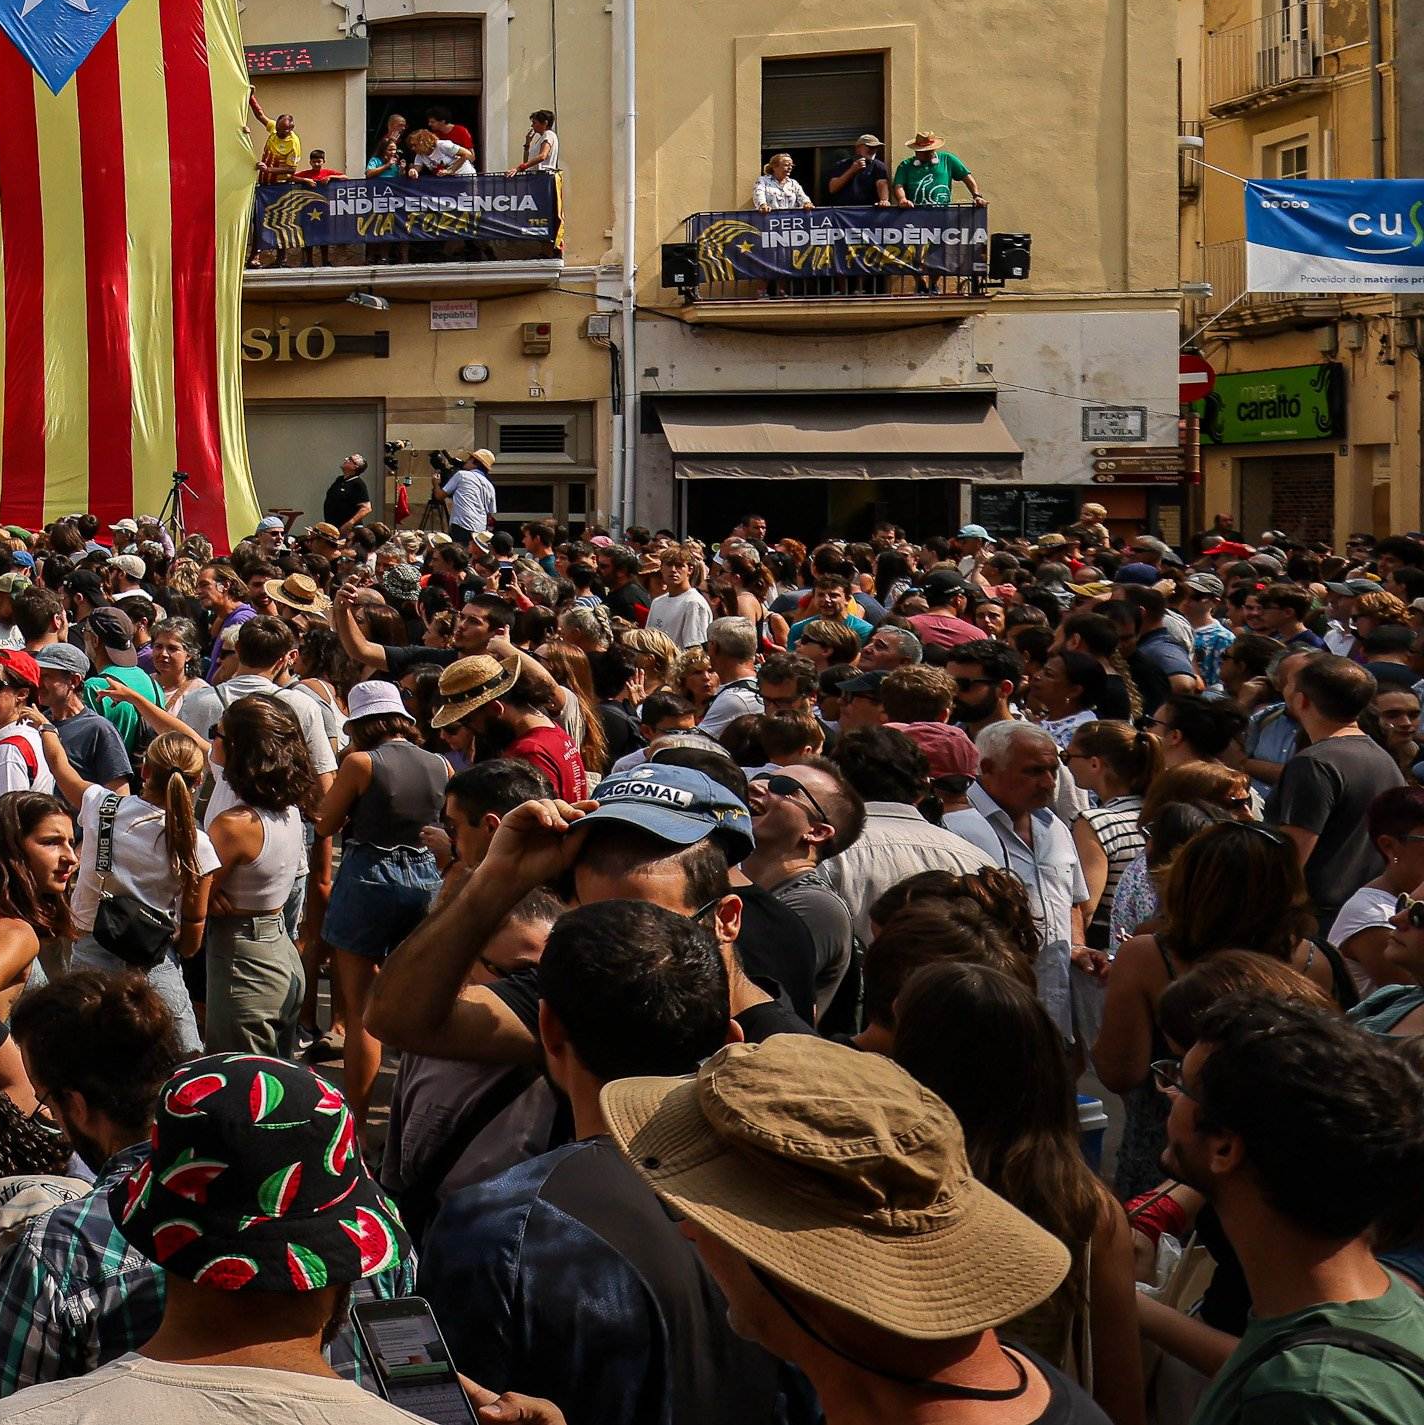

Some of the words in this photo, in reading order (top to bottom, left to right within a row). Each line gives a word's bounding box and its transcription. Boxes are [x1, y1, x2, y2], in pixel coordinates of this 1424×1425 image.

[329, 192, 538, 216] INDEPENDÈNCIA
[336, 187, 368, 199] PER
[373, 186, 394, 197] LA
[356, 214, 395, 237] VIA
[405, 211, 482, 236] FORA!
[769, 219, 804, 230] PER
[810, 216, 833, 228] LA
[761, 224, 988, 248] INDEPENDÈNCIA
[793, 244, 832, 270] VIA
[1350, 275, 1361, 283] de
[1364, 274, 1409, 284] matèries
